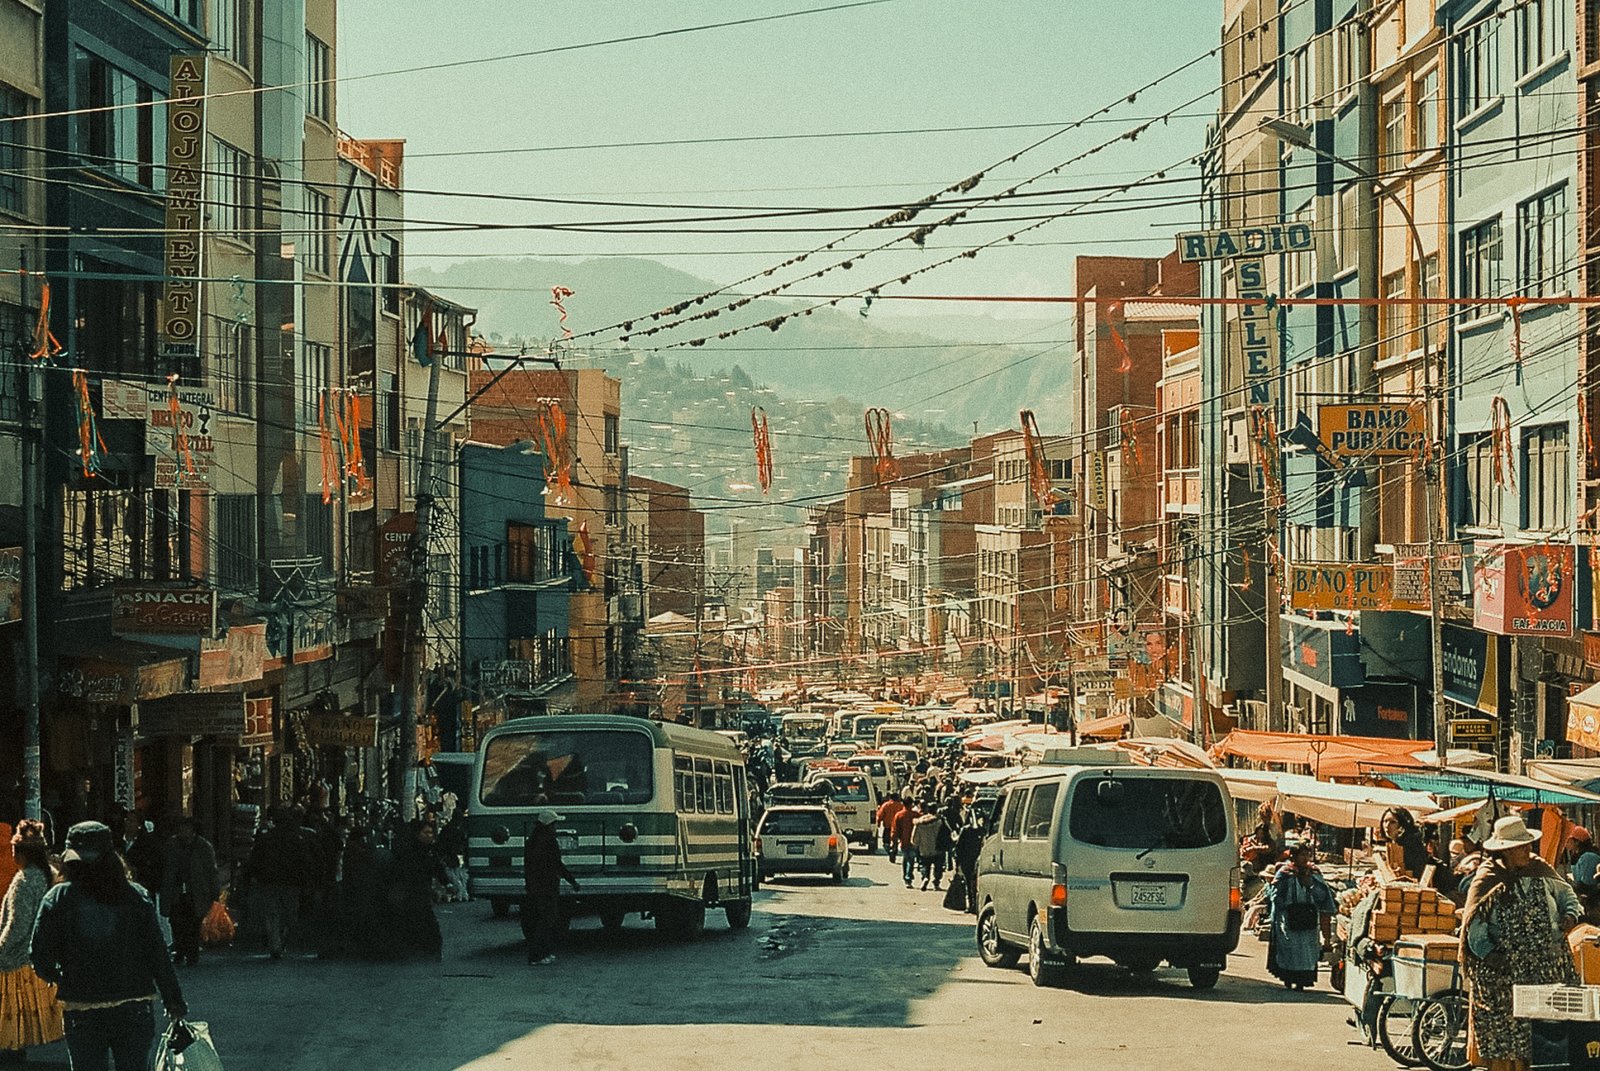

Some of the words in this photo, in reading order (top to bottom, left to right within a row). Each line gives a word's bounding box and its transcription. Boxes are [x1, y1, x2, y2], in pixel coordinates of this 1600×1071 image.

[166, 59, 200, 342] ALOJAMIENTO
[1185, 223, 1312, 259] RADIO
[1347, 404, 1409, 430] BAÑO
[134, 592, 210, 604] SNACK
